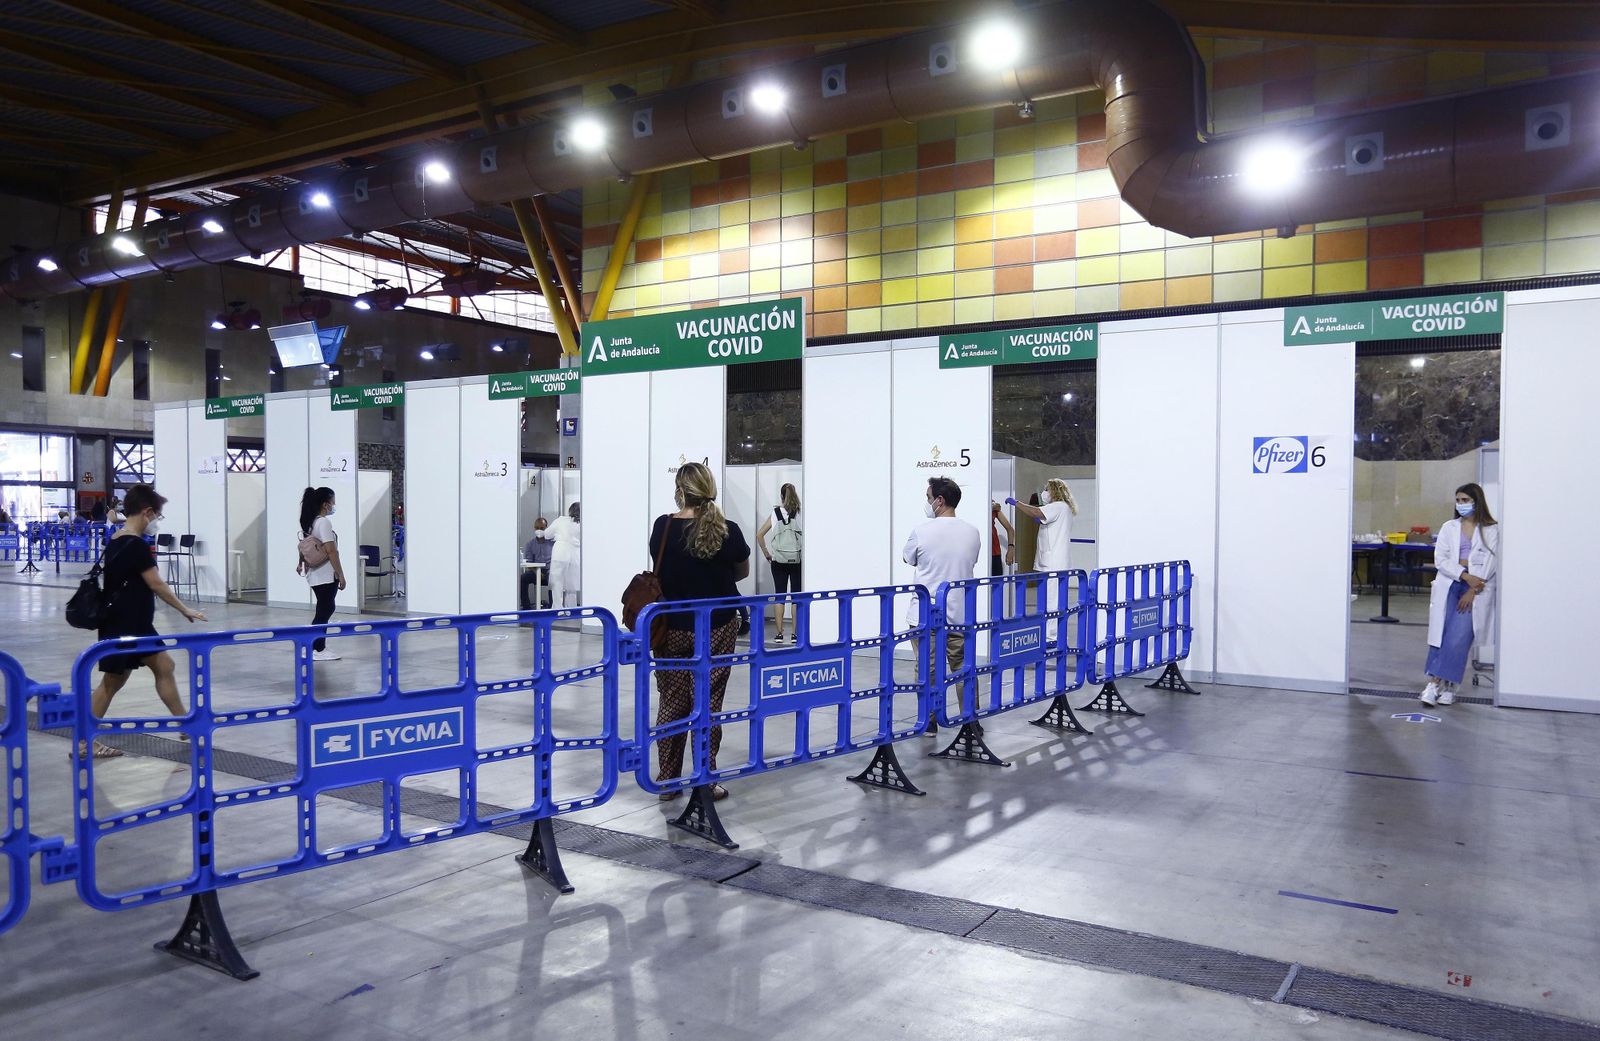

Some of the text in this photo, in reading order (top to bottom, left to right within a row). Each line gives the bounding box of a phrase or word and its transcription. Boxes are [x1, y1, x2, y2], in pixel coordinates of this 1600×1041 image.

[1381, 296, 1498, 320] VACUNACIÓN
[676, 305, 796, 340] VACUNACIÓN
[1314, 316, 1337, 325] Junta
[1314, 322, 1365, 333] de Andalucía
[1411, 316, 1466, 333] COVID
[610, 336, 632, 347] Junta
[1009, 327, 1094, 347] VACUNACIÓN
[610, 343, 660, 359] de Andalucía
[707, 335, 763, 359] COVID
[969, 348, 998, 357] Andalucía
[1031, 344, 1071, 358] COVID
[530, 369, 579, 384] VACUNACIÓN
[363, 384, 403, 396] VACUNACIÓN
[543, 382, 566, 392] COVID
[231, 396, 263, 407] VACUNACIÓN
[374, 395, 393, 404] COVID
[240, 405, 255, 414] COVID
[916, 448, 971, 468] AstraZeneca 5
[1257, 442, 1326, 473] Pfizer 6
[214, 461, 219, 474] 1
[341, 458, 348, 472] 2
[500, 462, 508, 477] 3
[530, 475, 536, 487] 4
[1140, 611, 1157, 622] FYCMA
[1014, 632, 1038, 648] FYCMA
[793, 667, 839, 686] FYCMA
[370, 720, 454, 749] FYCMA
